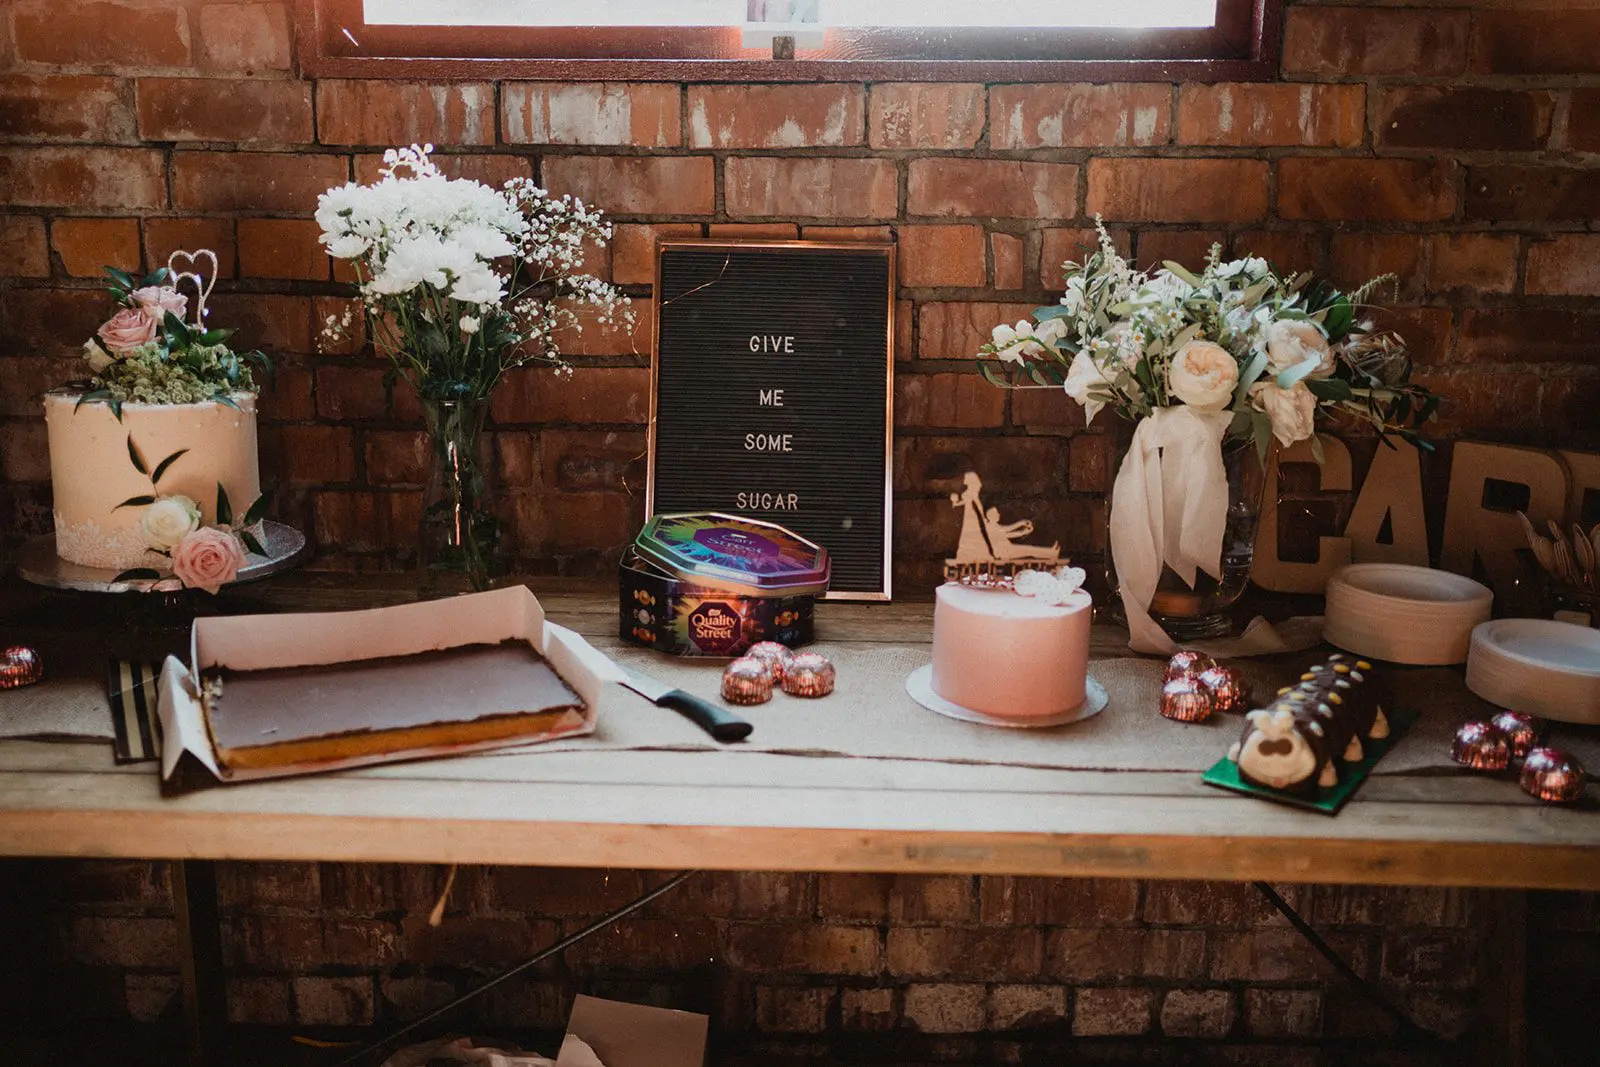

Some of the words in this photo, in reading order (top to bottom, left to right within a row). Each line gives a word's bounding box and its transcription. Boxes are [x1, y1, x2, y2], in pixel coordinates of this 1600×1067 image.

[749, 335, 796, 353] GIVE
[759, 388, 785, 407] ME
[743, 432, 794, 452] SOME
[735, 491, 799, 511] SUGAR
[1250, 432, 1600, 597] CAR
[691, 612, 738, 630] Quality
[696, 626, 733, 639] Street
